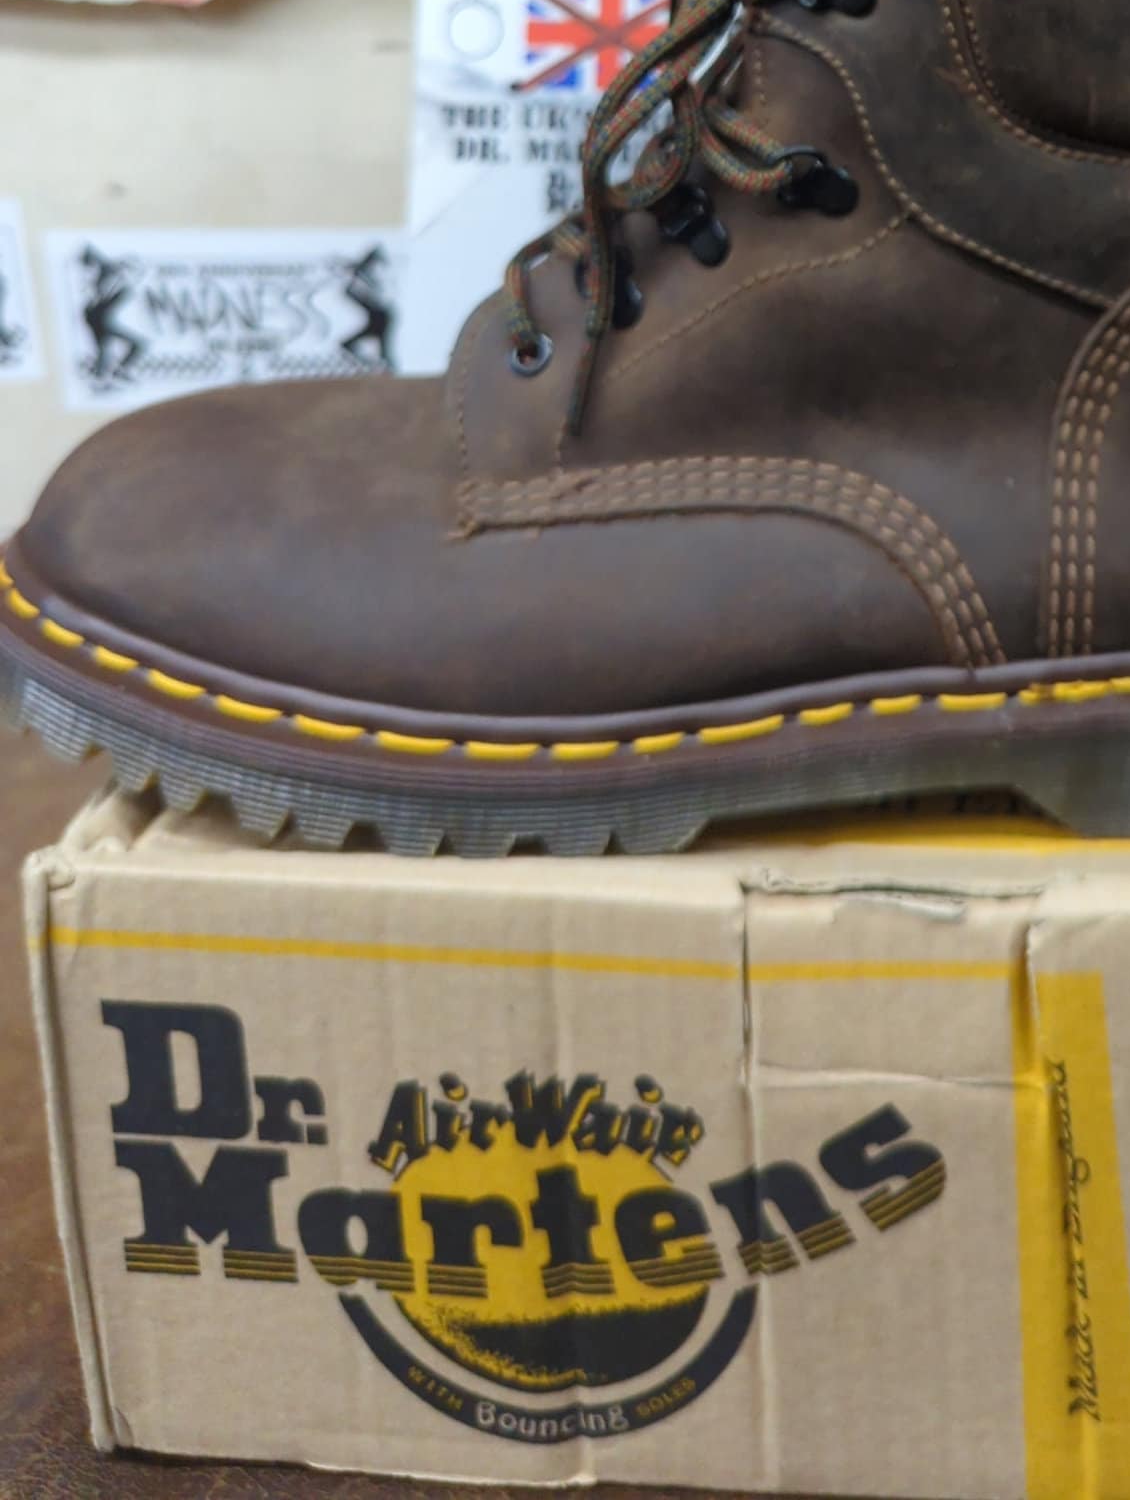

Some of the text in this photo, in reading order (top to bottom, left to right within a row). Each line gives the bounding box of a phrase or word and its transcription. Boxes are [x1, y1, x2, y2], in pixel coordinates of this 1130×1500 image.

[439, 104, 590, 131] THE UK'
[143, 280, 333, 340] MADNESS
[100, 998, 328, 1146] Dr.
[367, 1067, 706, 1180] AirWair
[113, 1102, 948, 1299] Martens
[406, 1364, 698, 1439] WITH Bouncing SOLES
